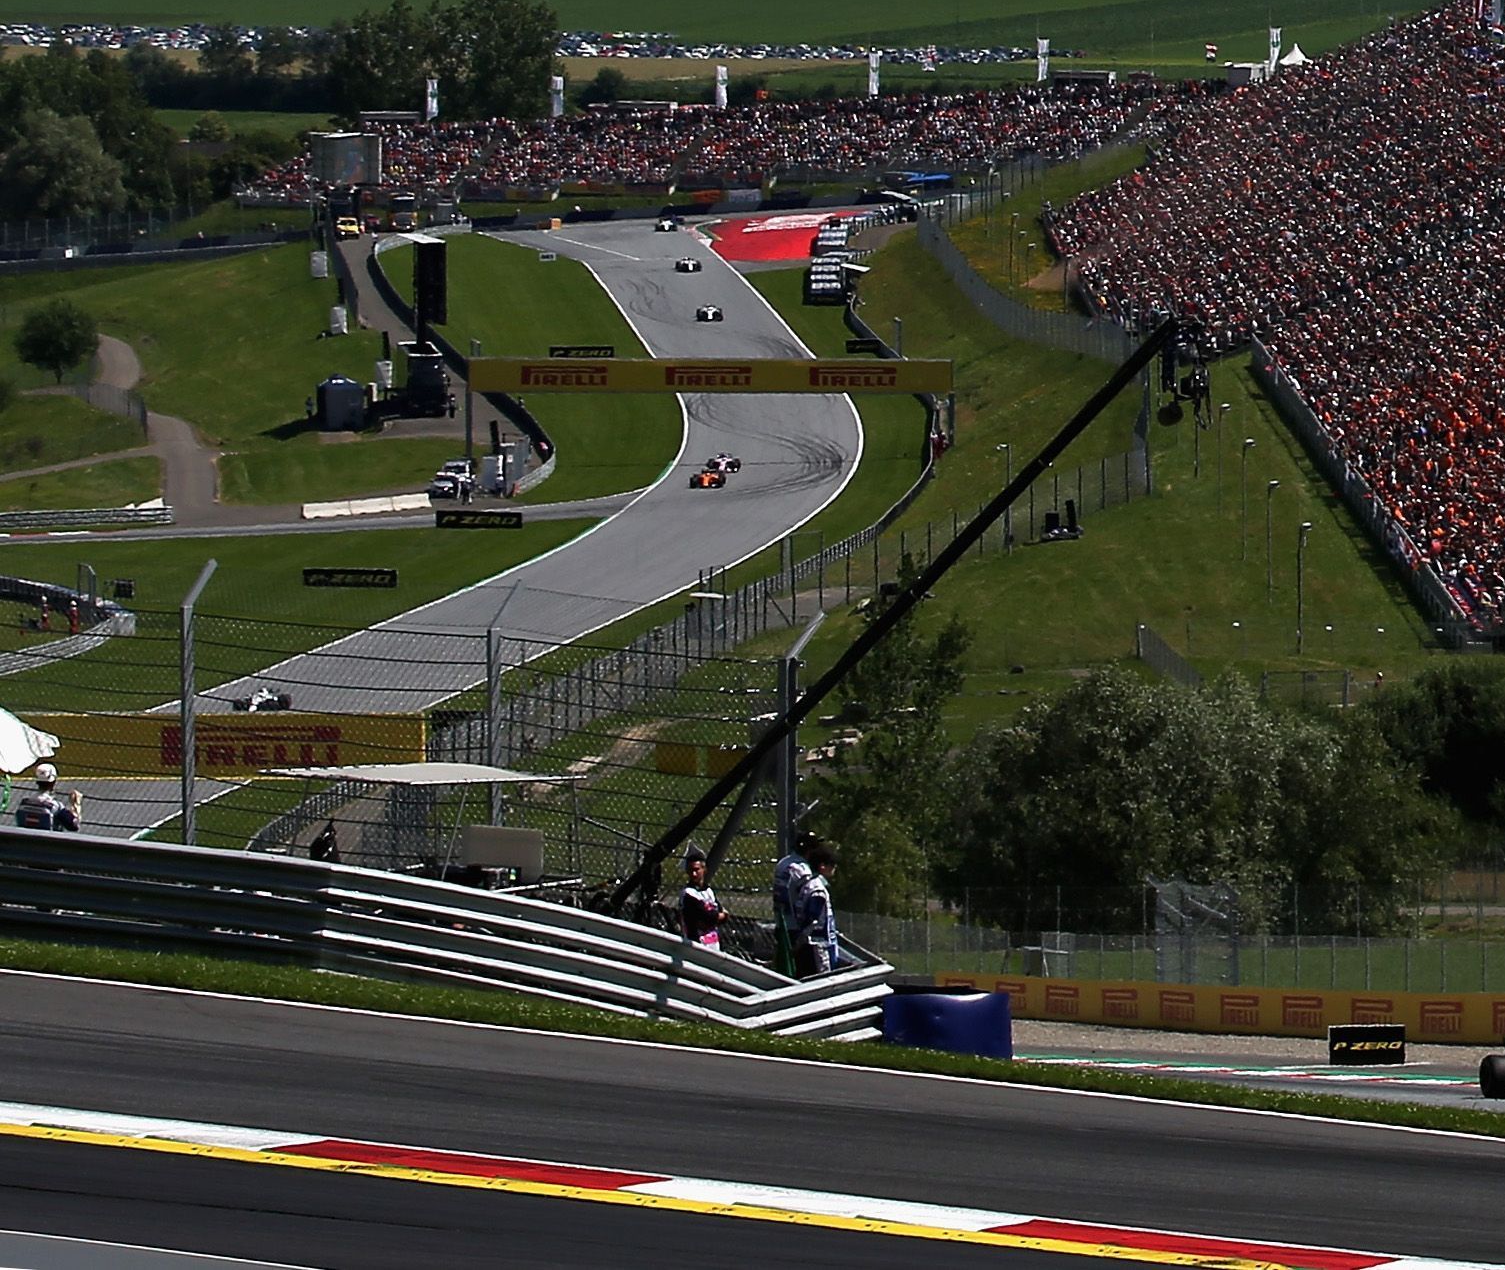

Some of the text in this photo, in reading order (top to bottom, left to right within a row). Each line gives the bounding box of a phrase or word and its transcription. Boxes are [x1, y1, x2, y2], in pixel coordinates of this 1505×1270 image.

[521, 366, 607, 385] PIRELLI
[665, 366, 752, 386] PIRELLI
[809, 366, 897, 386] PIRELLI
[441, 515, 517, 524] P ZERO
[162, 726, 342, 765] PRELLI
[1102, 988, 1138, 1020] PIRELLI
[1159, 990, 1195, 1022] PIRELLI
[1220, 994, 1259, 1026] PIRELLI
[1282, 996, 1323, 1029] PIRELLI
[1420, 1001, 1463, 1034] PIRELLI
[1333, 1041, 1402, 1050] P ZERO
